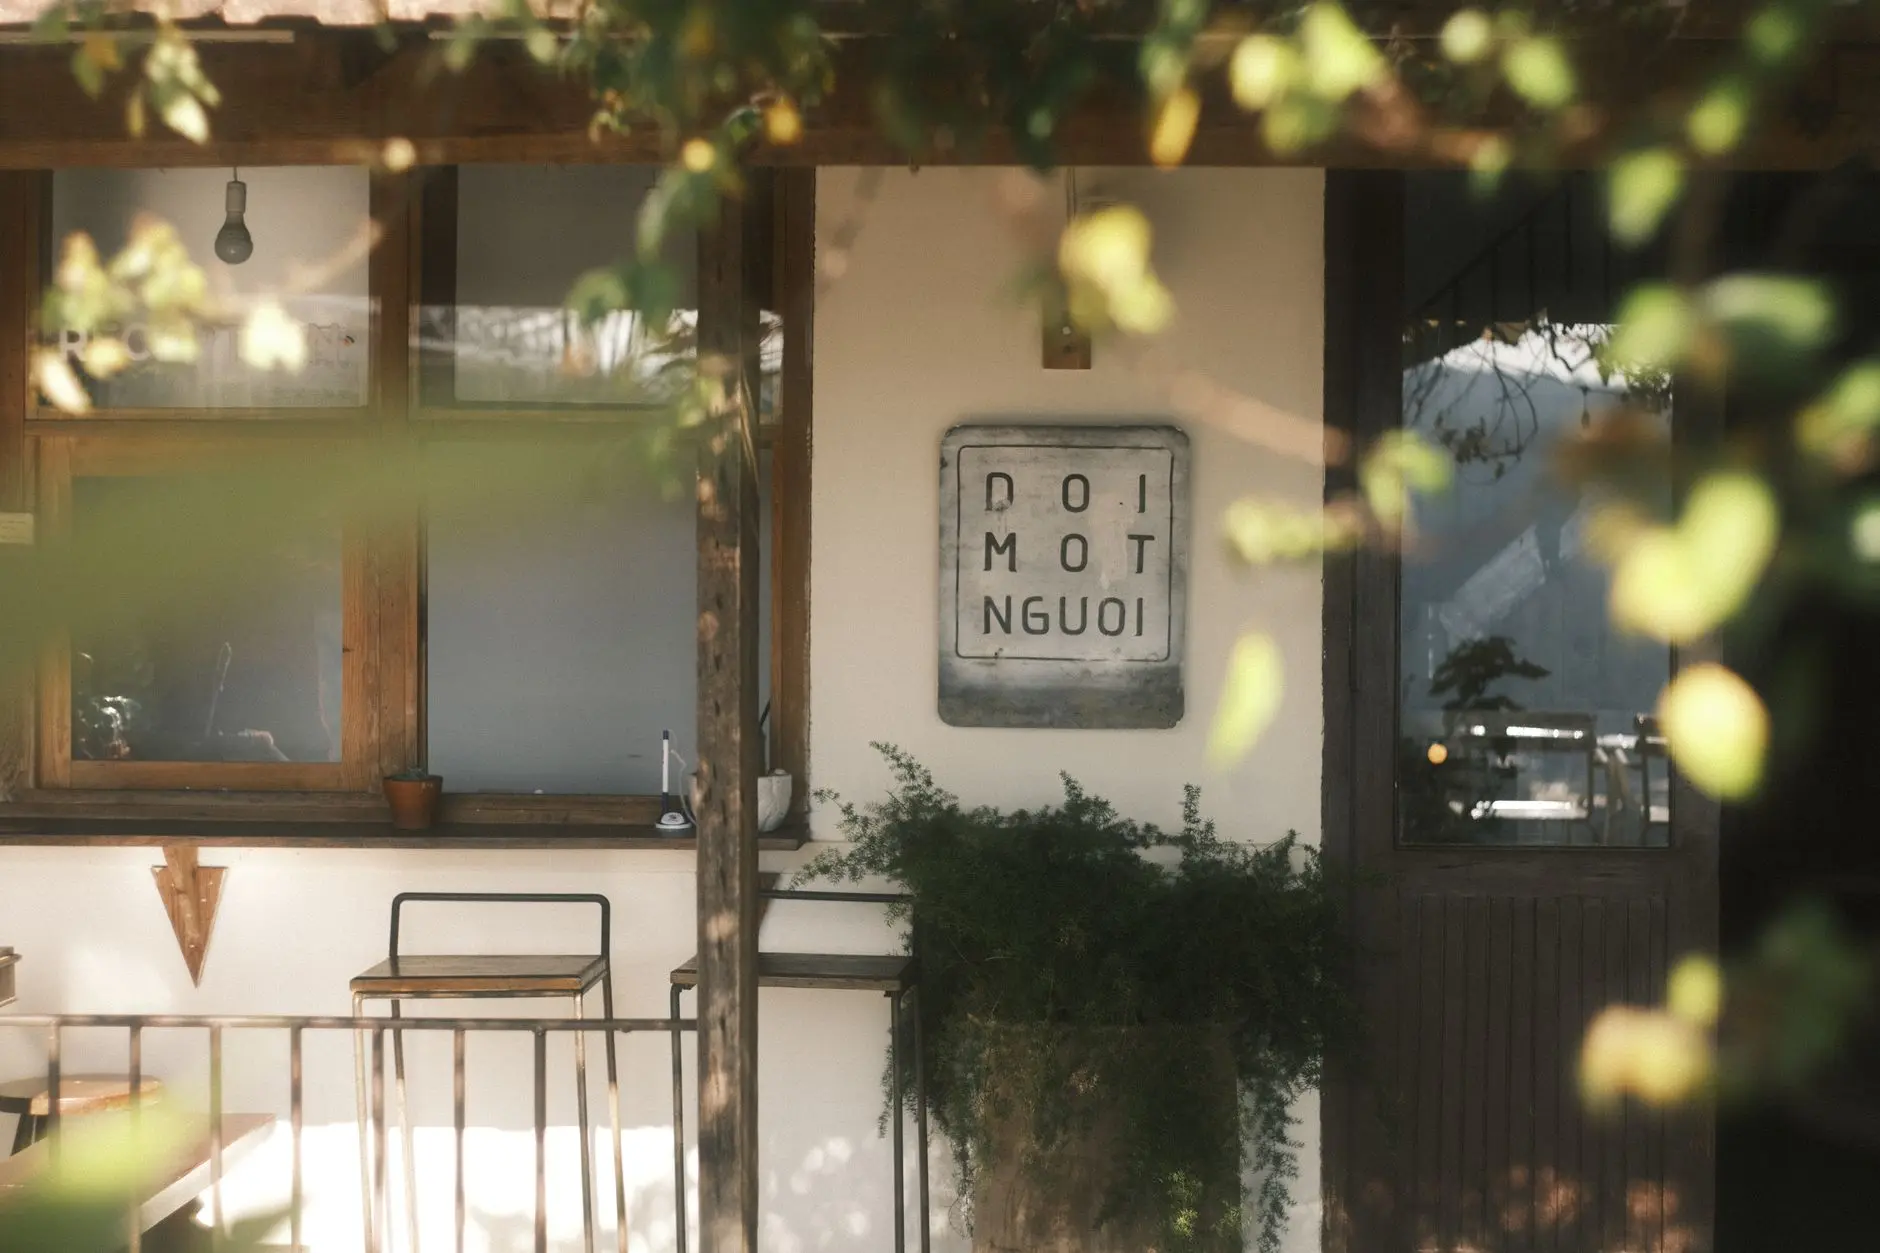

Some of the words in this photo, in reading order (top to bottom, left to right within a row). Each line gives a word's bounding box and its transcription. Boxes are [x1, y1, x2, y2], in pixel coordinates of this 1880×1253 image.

[985, 472, 1146, 513] DOI
[983, 532, 1155, 573] MOT
[983, 595, 1144, 636] NGUOI
